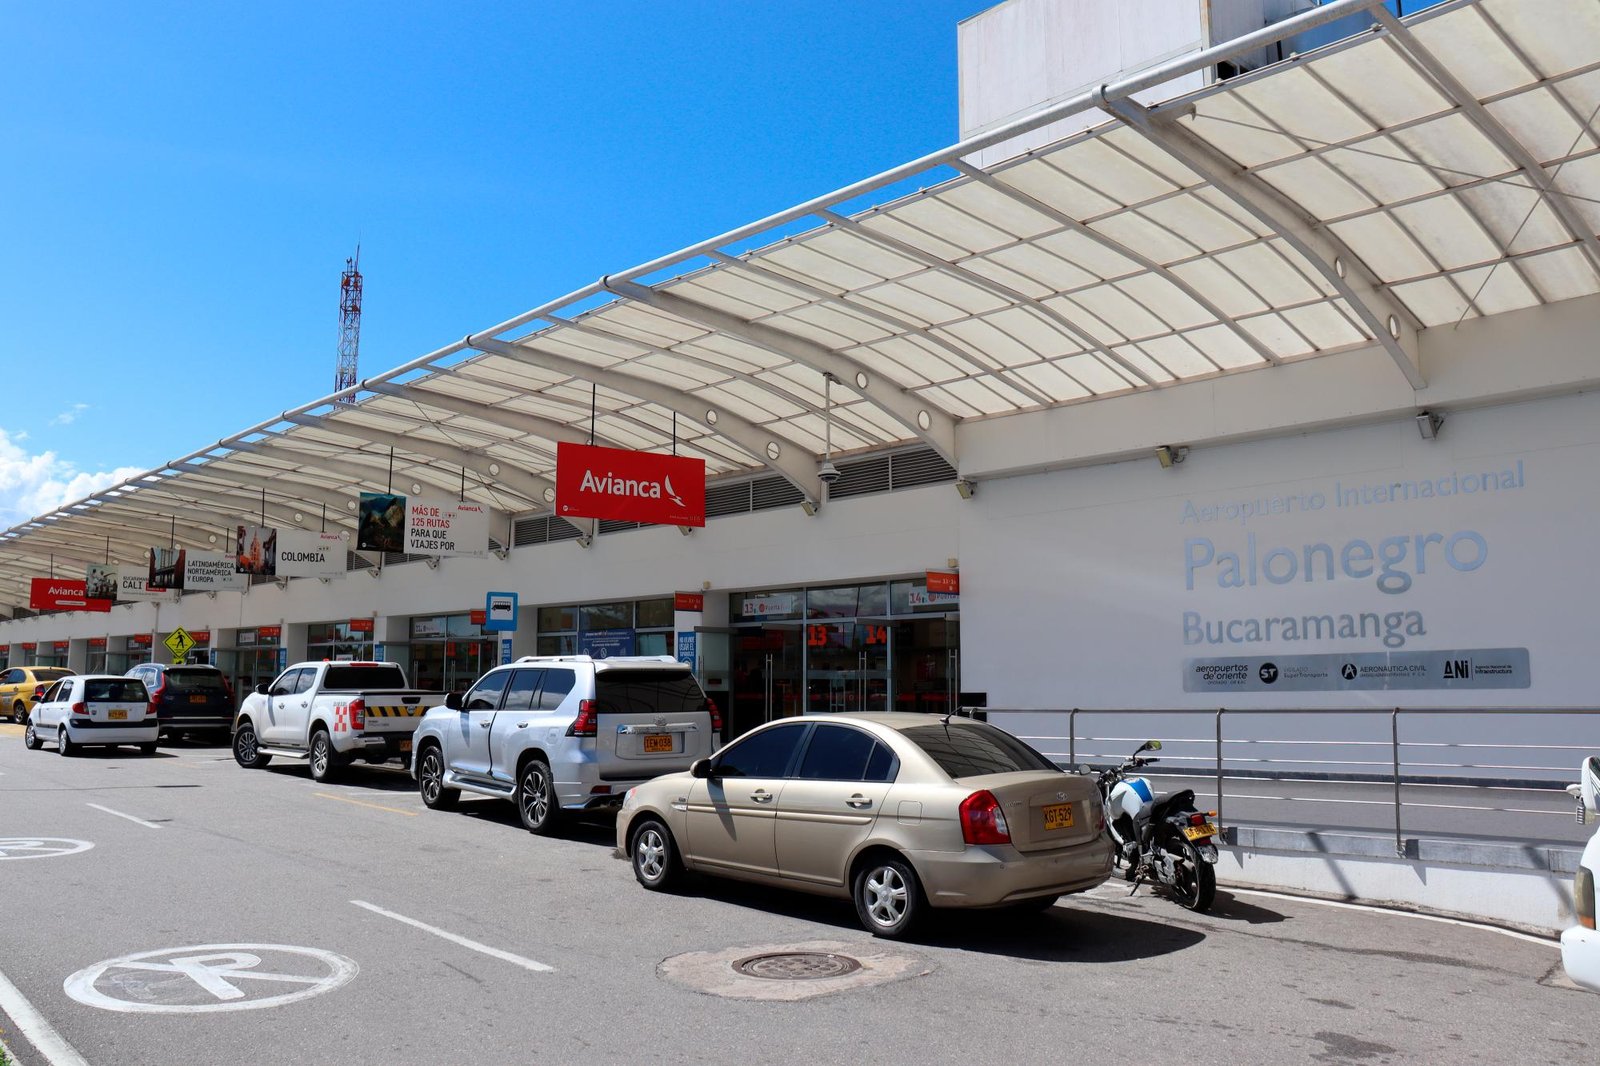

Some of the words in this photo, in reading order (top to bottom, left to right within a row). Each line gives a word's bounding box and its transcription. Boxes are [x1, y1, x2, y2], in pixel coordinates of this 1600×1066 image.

[579, 469, 661, 499] Avianca
[1179, 491, 1326, 526] Aeropuerto
[1334, 459, 1526, 508] Internacional
[411, 504, 428, 516] MÁS
[431, 508, 440, 517] DE
[411, 518, 425, 527] 125
[427, 518, 450, 529] RUTAS
[410, 528, 431, 538] PARA
[432, 530, 447, 540] QUE
[410, 539, 439, 550] VIAJES
[440, 541, 455, 551] POR
[281, 551, 325, 562] COLOMBIA
[1183, 530, 1489, 595] Palonegro
[122, 580, 142, 589] CALI
[48, 586, 84, 597] Avianca
[808, 624, 827, 645] 13
[866, 624, 886, 643] 14
[1183, 610, 1427, 648] Bucaramanga
[1195, 663, 1249, 675] aeropuertos
[1260, 668, 1277, 680] ST
[1409, 664, 1427, 672] CIVIL
[1203, 671, 1215, 680] de
[1216, 670, 1248, 680] oriente
